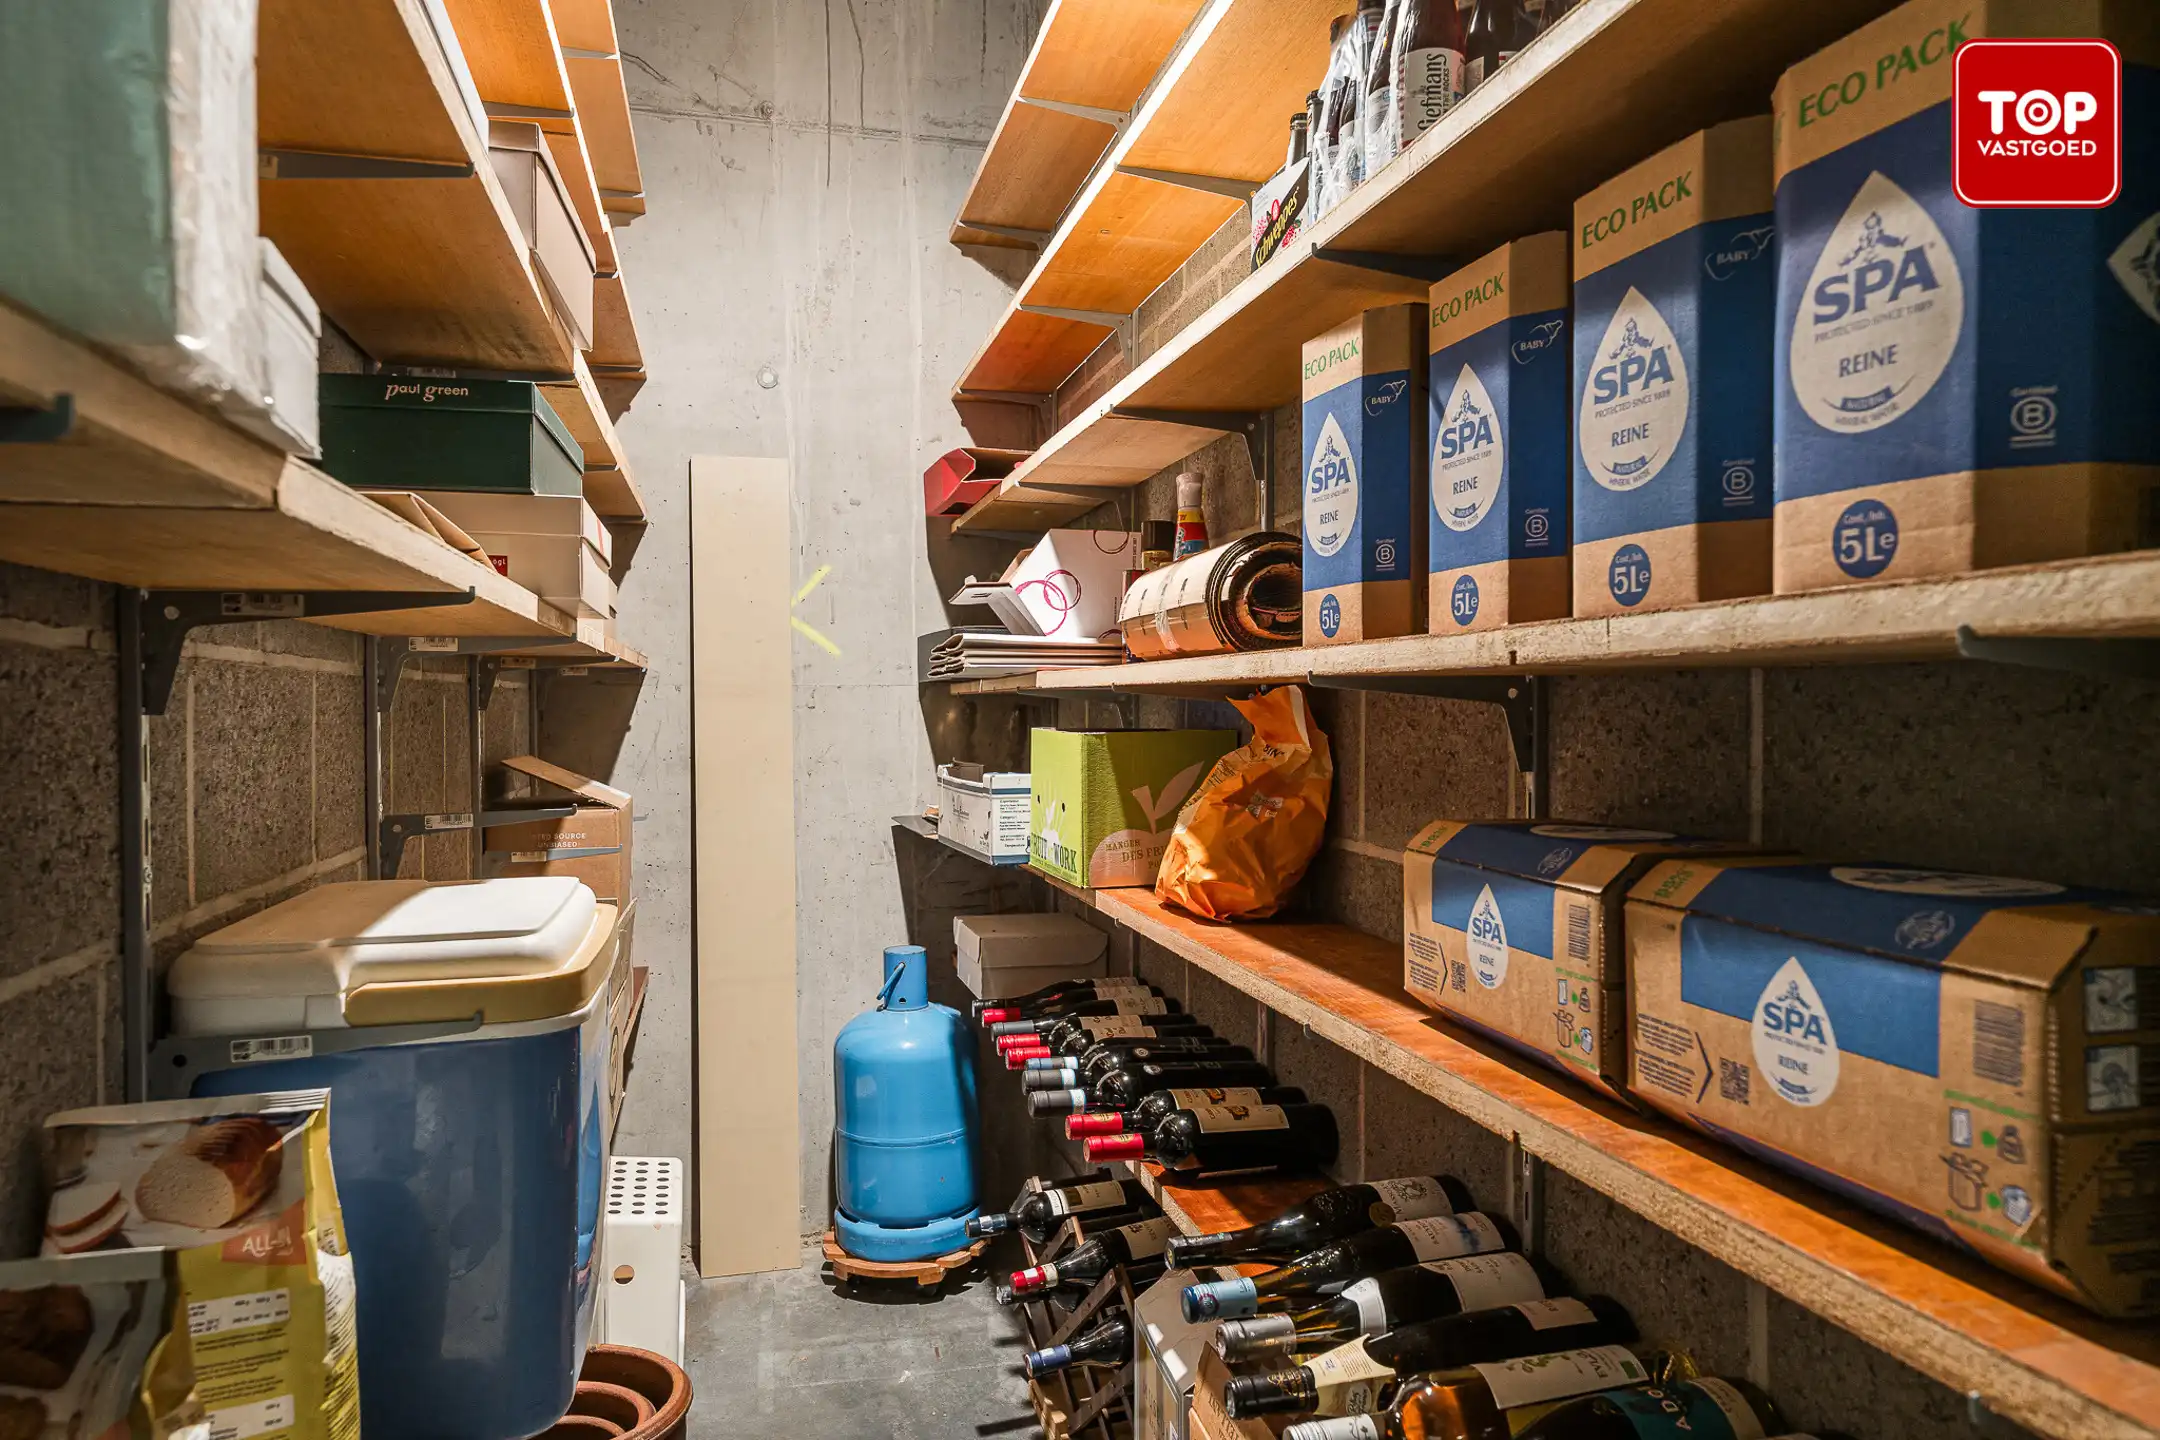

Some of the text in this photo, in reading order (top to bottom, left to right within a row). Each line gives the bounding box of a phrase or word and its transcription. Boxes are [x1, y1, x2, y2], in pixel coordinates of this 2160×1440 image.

[1442, 68, 1450, 93] ROCKS
[1799, 11, 1972, 128] ECO PACK
[1582, 170, 1693, 250] ECO PACK
[1255, 188, 1300, 268] Schweppes
[1716, 251, 1751, 266] BABY
[1431, 272, 1504, 328] ECO PACK
[1814, 246, 1941, 325] SPA
[1304, 337, 1359, 380] ECO PACK
[1520, 340, 1545, 351] BABY
[1593, 346, 1675, 406] SPA
[1839, 344, 1898, 378] REINE
[384, 383, 469, 402] paul green
[1371, 396, 1392, 405] BABY
[1441, 414, 1494, 460] SPA
[1611, 423, 1650, 447] REINE
[1311, 456, 1351, 494] SPA
[1453, 476, 1478, 495] REINE
[1320, 510, 1339, 525] REINE
[553, 832, 587, 841] SOURCE
[1105, 839, 1141, 852] MANGER
[1053, 842, 1078, 874] WORK
[1122, 847, 1144, 863] DES
[1472, 917, 1503, 945] SPA
[1763, 1002, 1828, 1046] SPA
